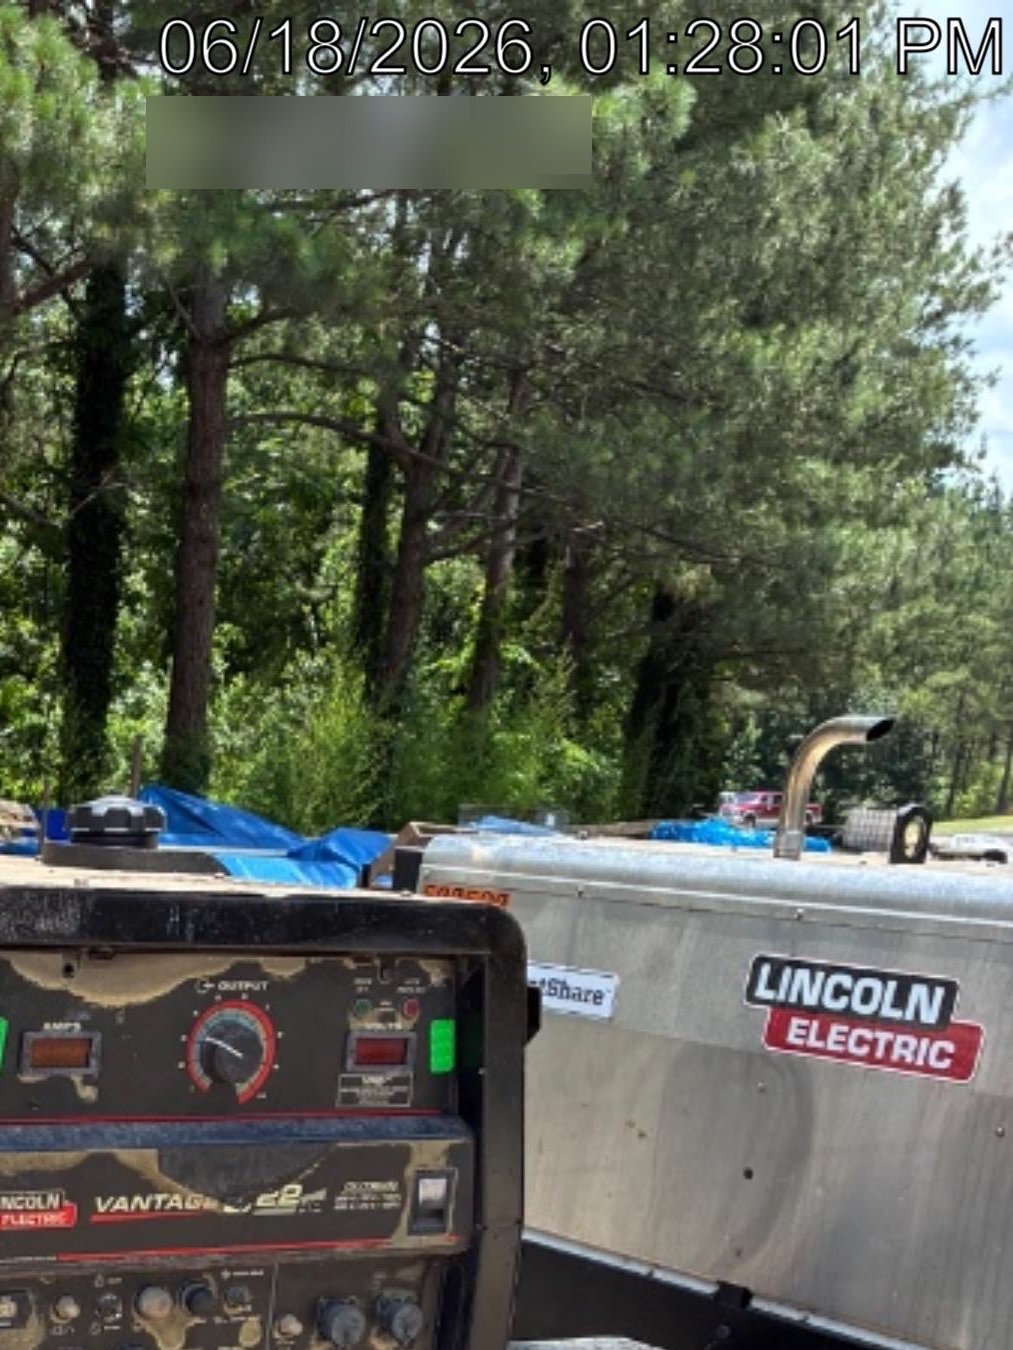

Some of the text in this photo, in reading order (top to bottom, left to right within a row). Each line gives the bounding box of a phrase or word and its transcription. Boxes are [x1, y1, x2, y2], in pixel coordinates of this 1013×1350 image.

[529, 977, 605, 1006] tShare
[754, 963, 946, 1024] LINCOLN
[786, 1017, 956, 1069] ELECTRIC
